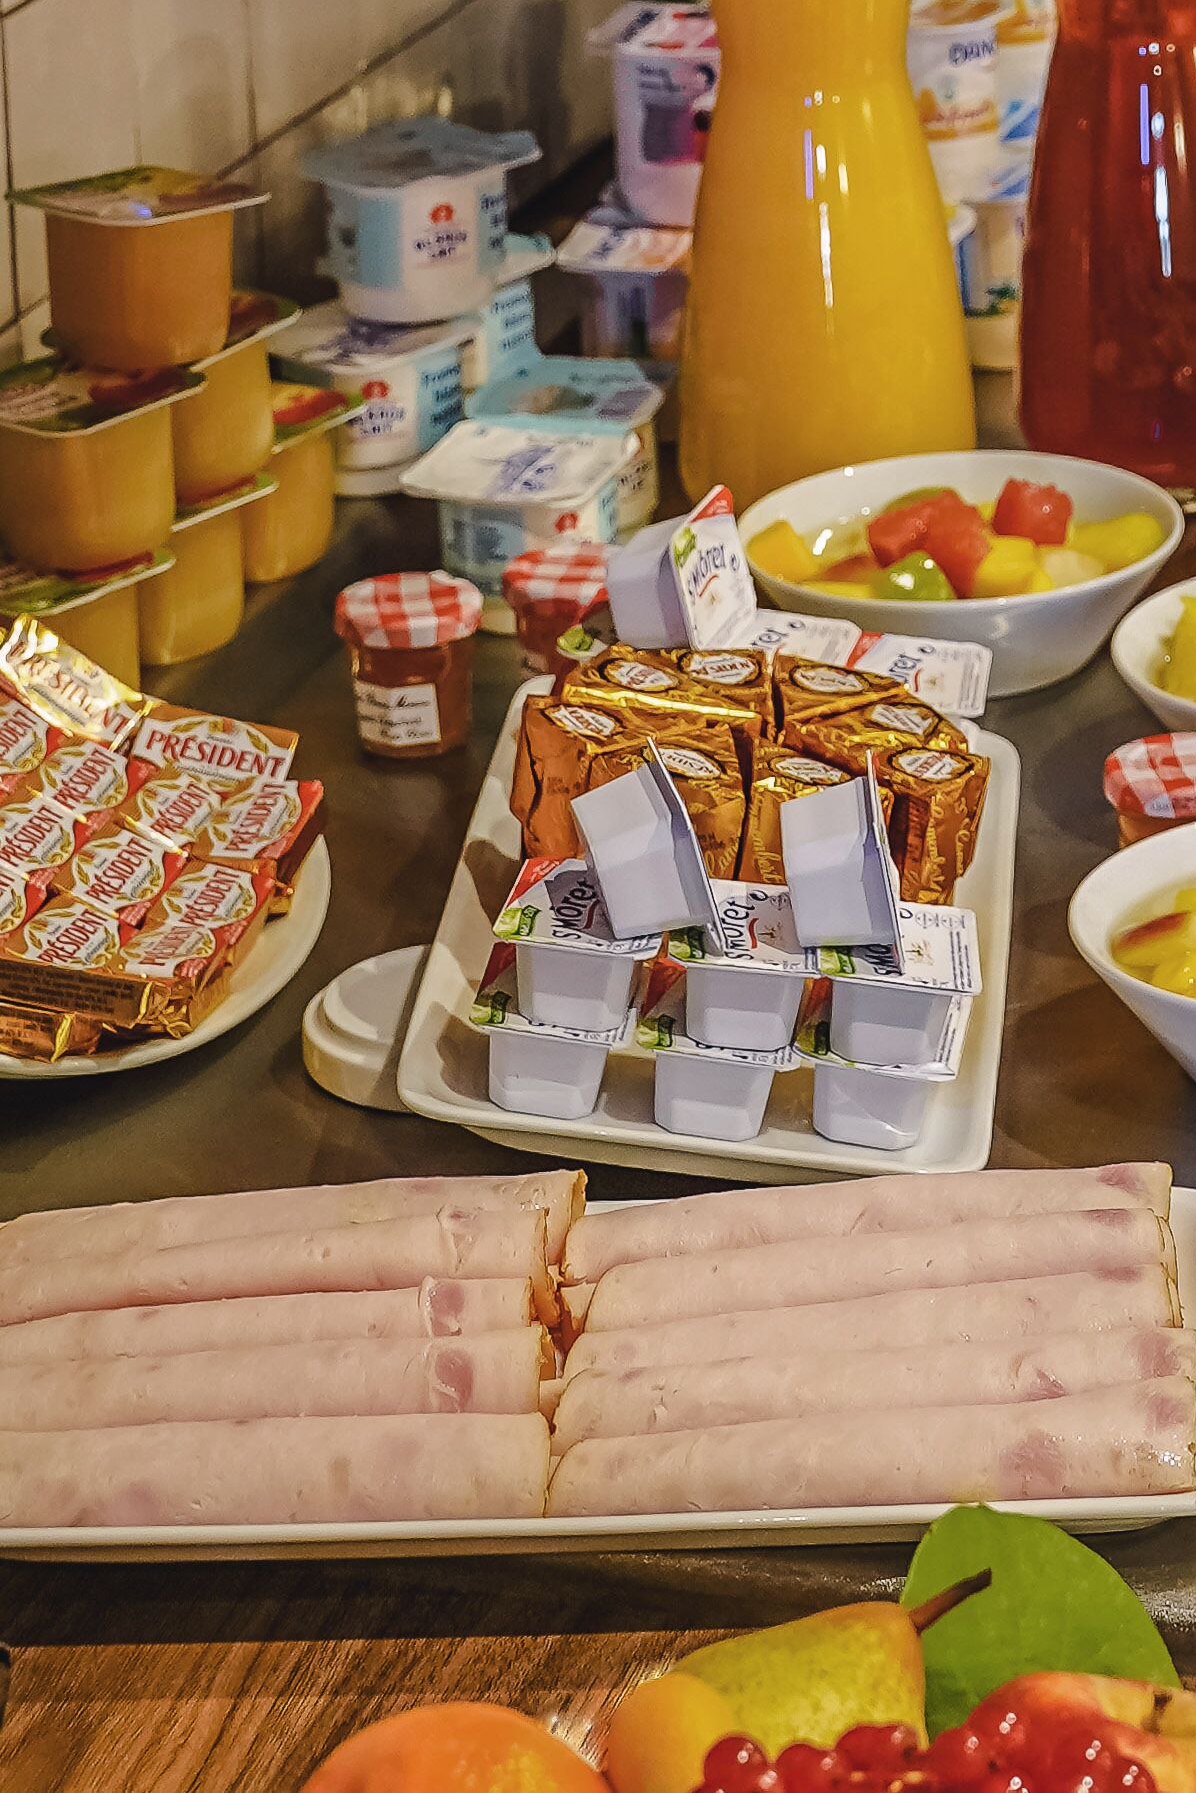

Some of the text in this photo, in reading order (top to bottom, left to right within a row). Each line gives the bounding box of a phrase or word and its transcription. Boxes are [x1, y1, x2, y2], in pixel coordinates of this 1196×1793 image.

[53, 747, 116, 810] PRÉSIDENT
[146, 728, 285, 778] PRÉSIDENT
[1, 805, 64, 868] PRÉSIDENT
[151, 782, 211, 834] PRÉSIDENT
[224, 783, 287, 852] PRÉSIDENT
[86, 837, 153, 904] PRÉSIDENT
[178, 869, 241, 928] PRÉSIDENT
[38, 908, 109, 963] PRÉSIDENT
